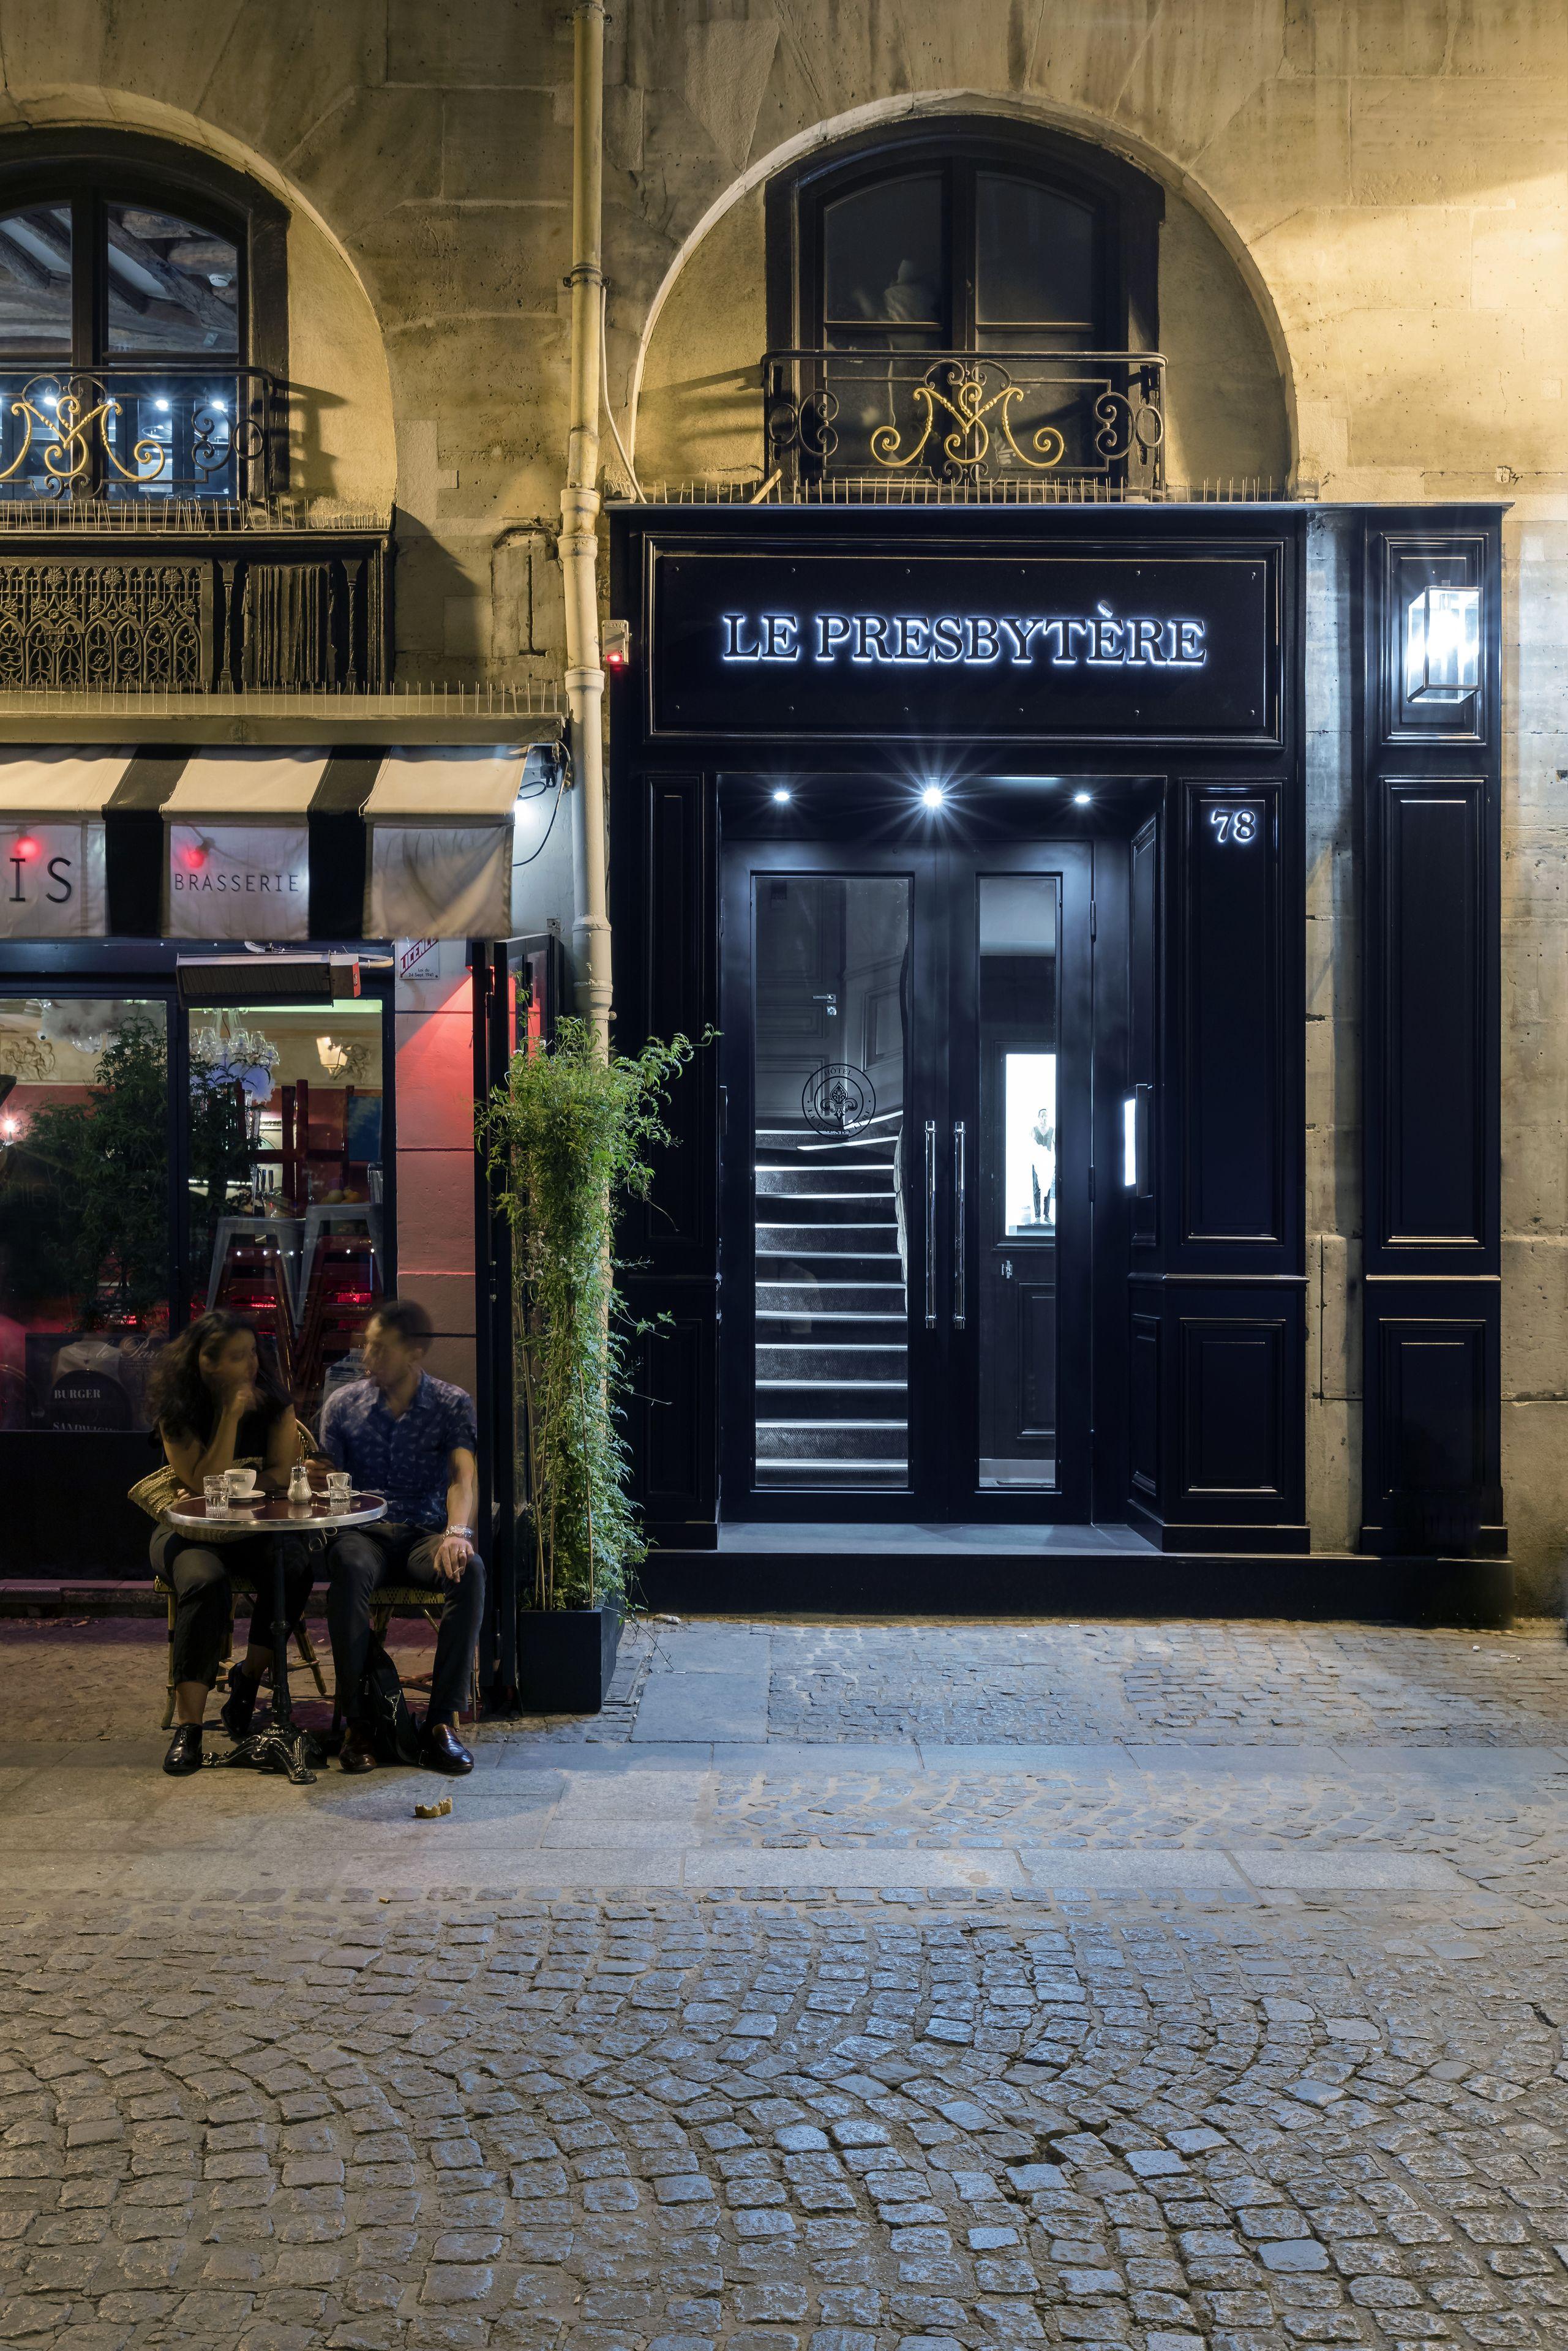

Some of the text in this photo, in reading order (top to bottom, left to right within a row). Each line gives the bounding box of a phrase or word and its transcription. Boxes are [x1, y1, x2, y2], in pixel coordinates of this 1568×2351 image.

[722, 600, 1208, 666] LE PRESBYTÈRE
[1211, 809, 1256, 843] 78
[174, 873, 299, 893] BRASSERIE
[824, 1067, 852, 1077] HÔTEL
[54, 1389, 101, 1400] BURGER
